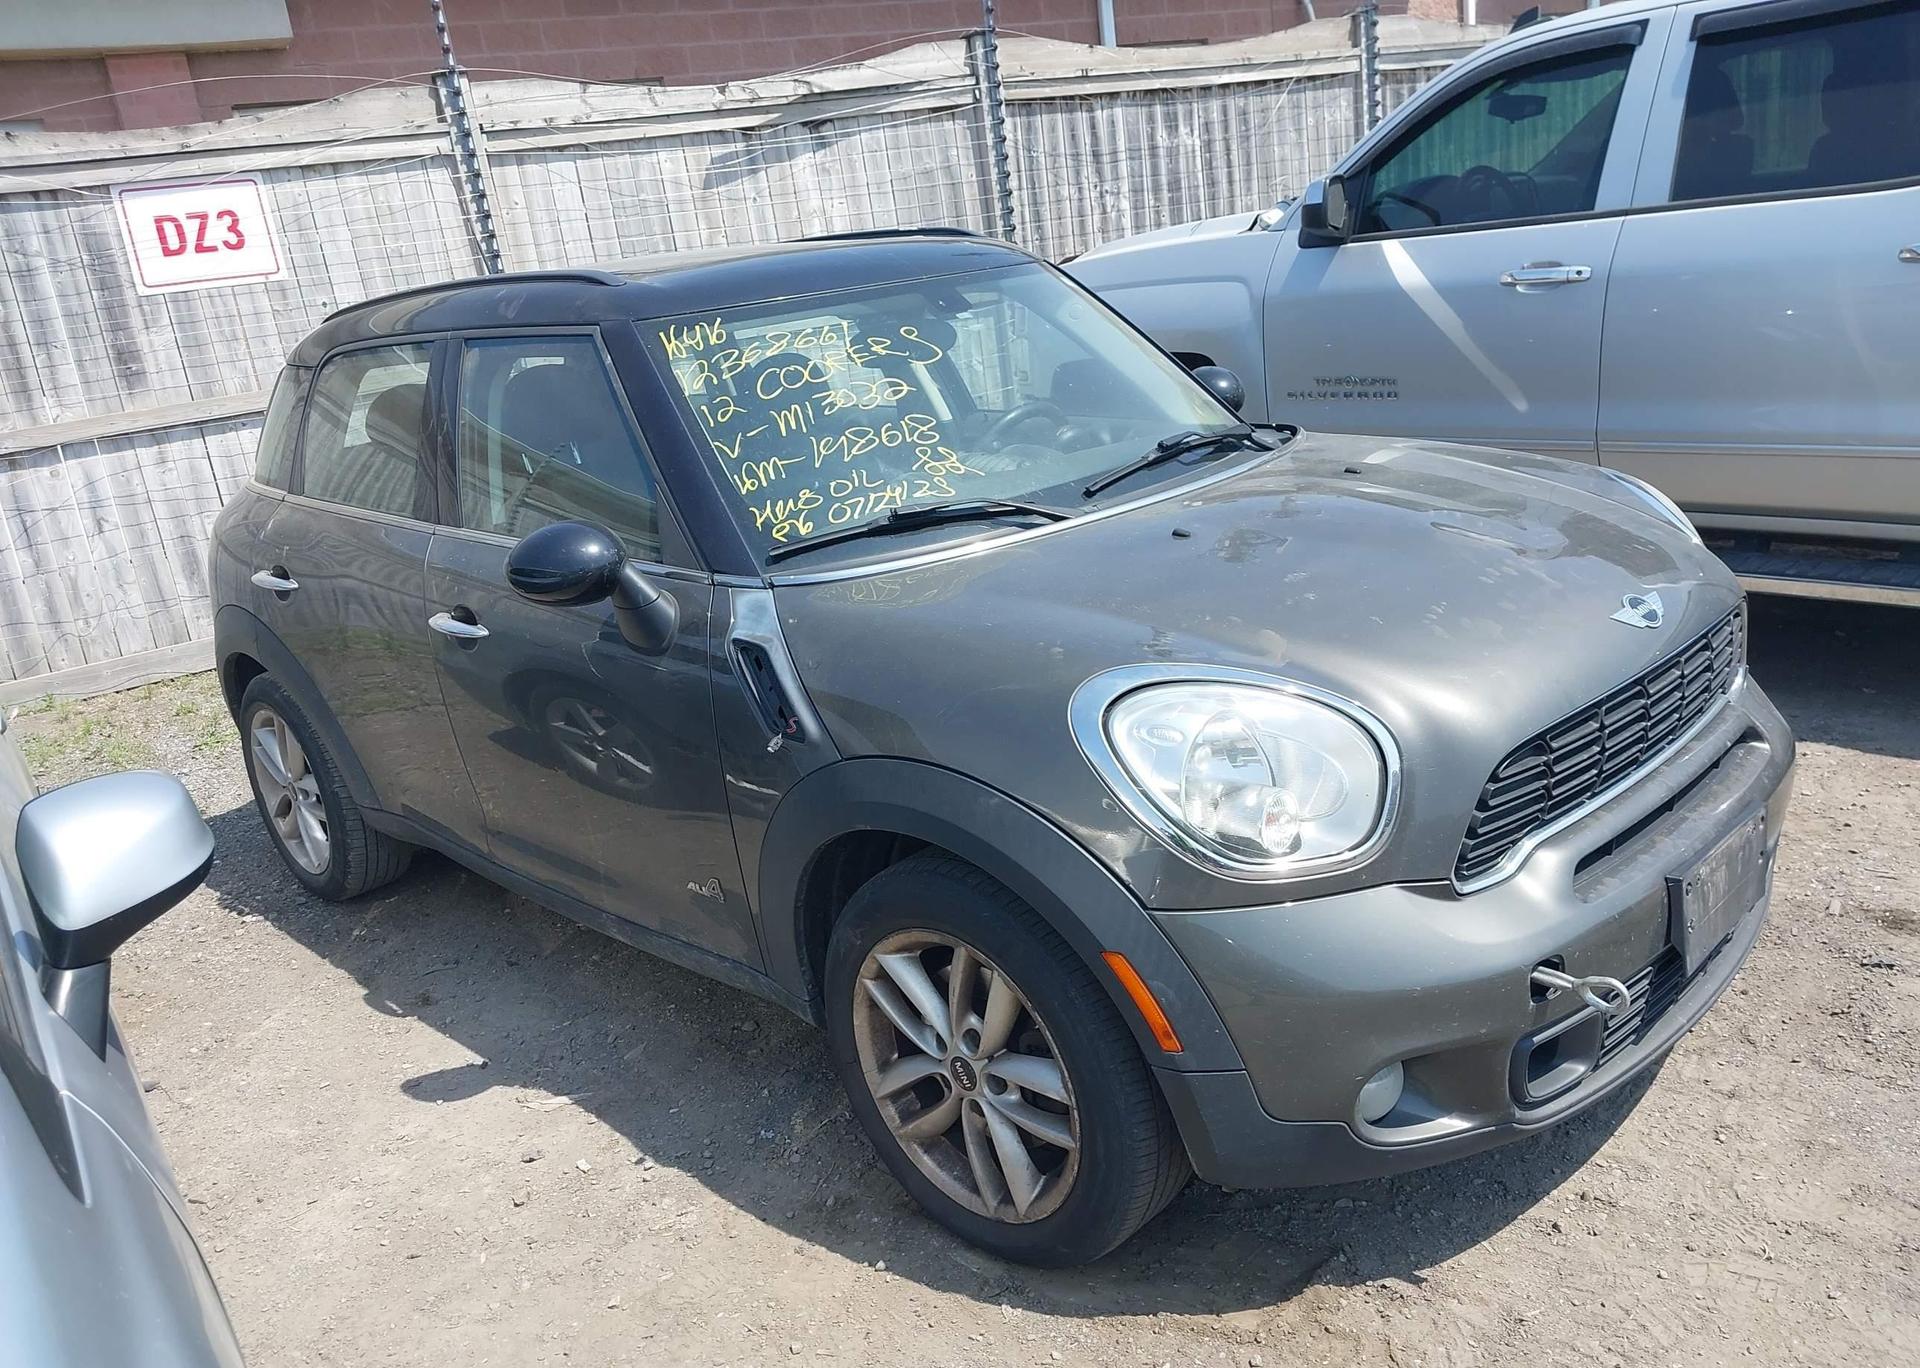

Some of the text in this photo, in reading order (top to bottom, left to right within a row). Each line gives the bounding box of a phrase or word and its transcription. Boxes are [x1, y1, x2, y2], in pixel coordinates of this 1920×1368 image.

[153, 209, 246, 258] DZ3
[700, 395, 748, 428] 12
[900, 326, 943, 365] S
[829, 469, 885, 498] OIL
[954, 1061, 972, 1088] MINI
